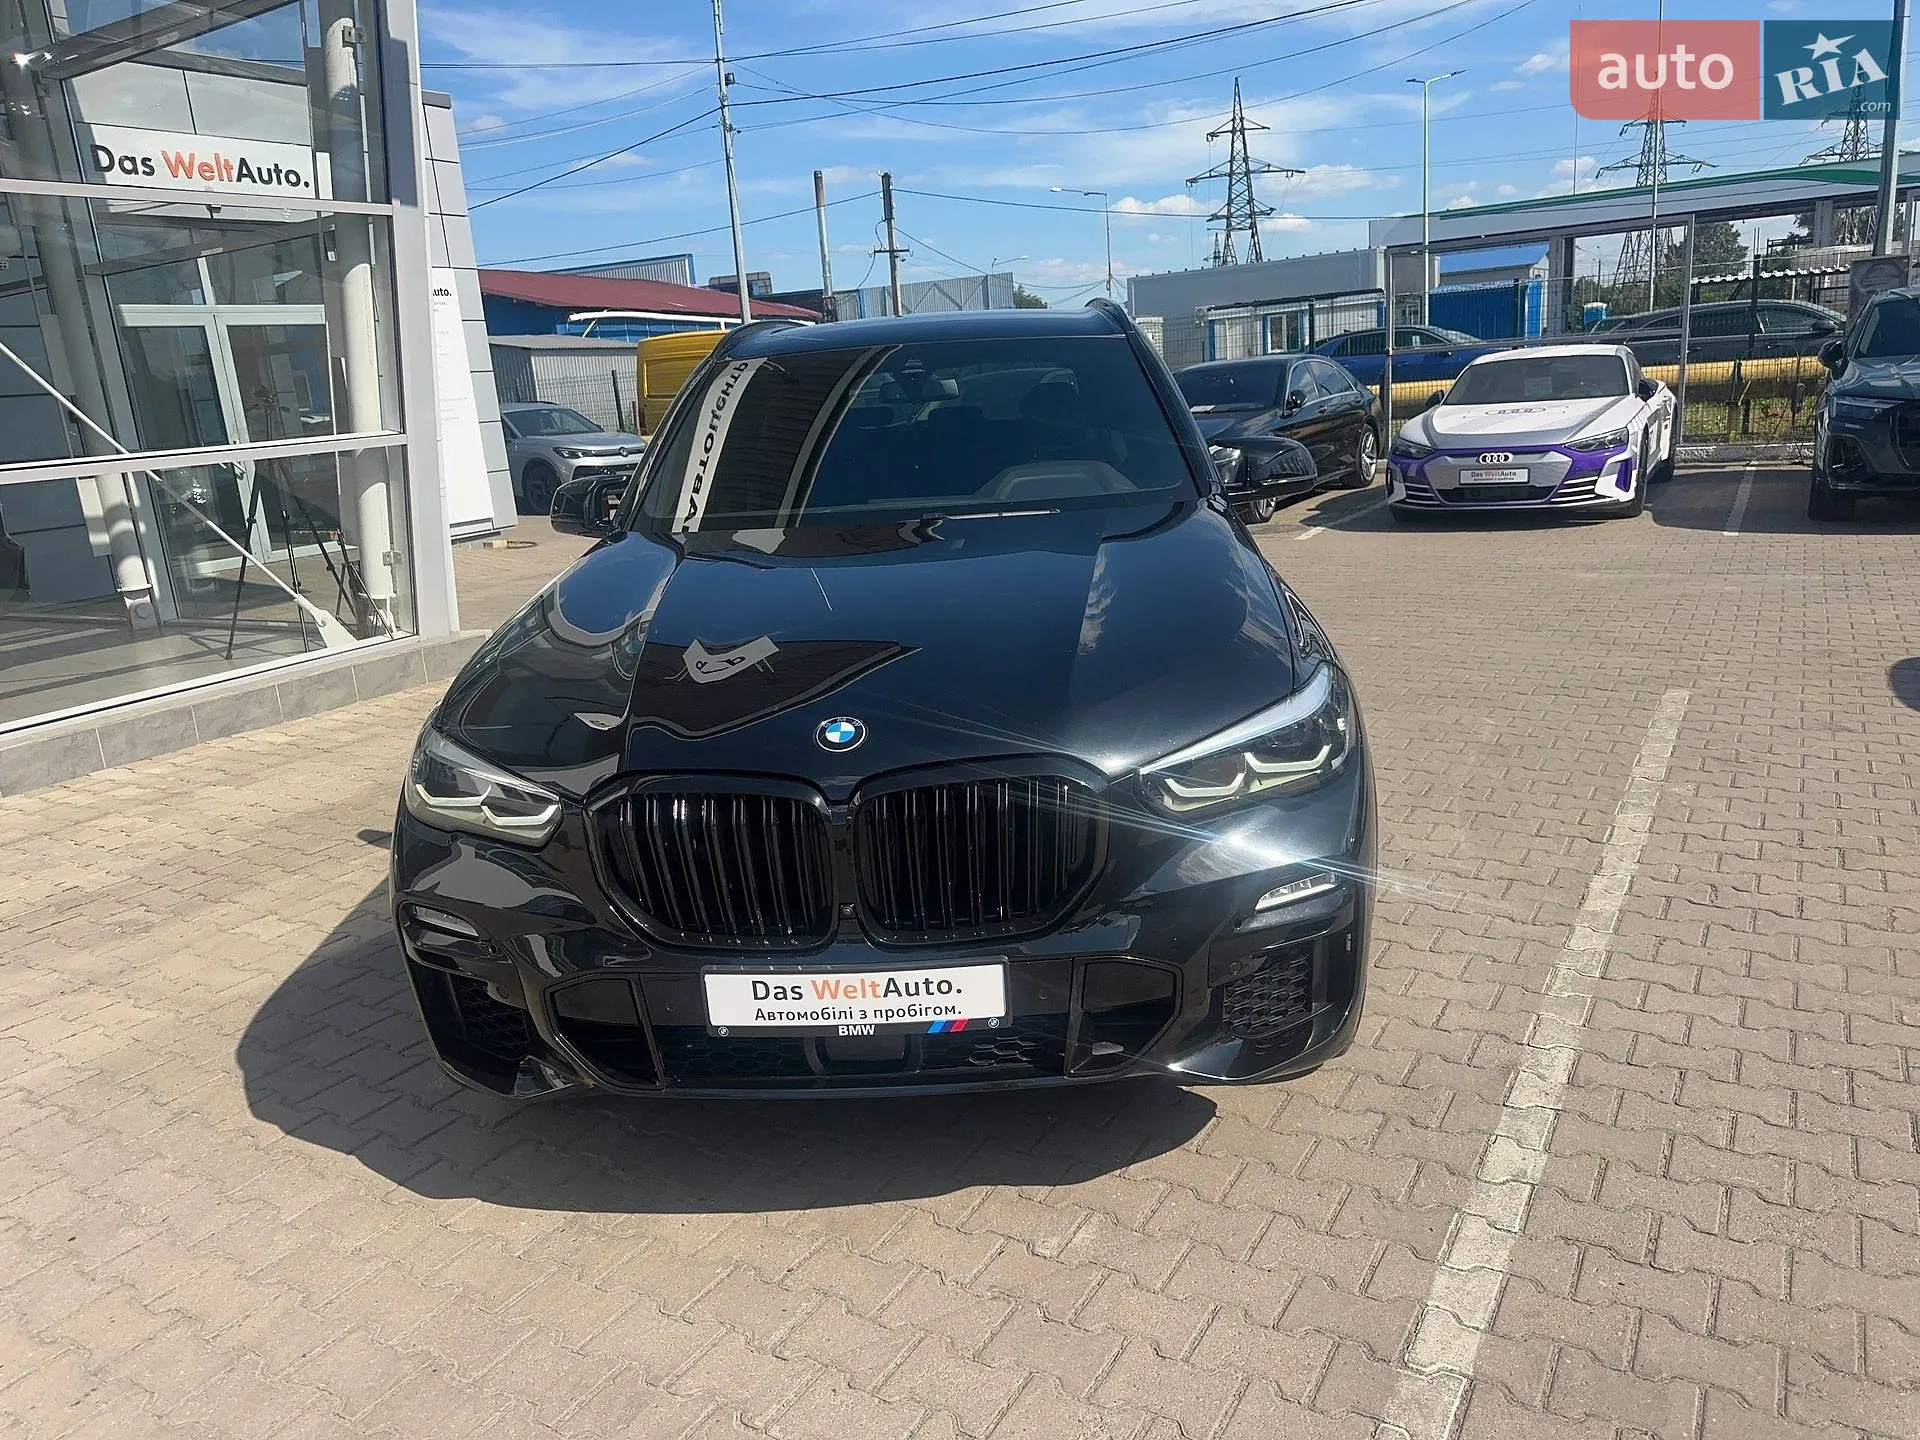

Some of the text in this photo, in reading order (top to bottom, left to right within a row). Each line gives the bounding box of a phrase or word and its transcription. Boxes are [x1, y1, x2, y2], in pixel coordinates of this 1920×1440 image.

[89, 144, 310, 188] Das WeltAuto.
[432, 287, 452, 297] uto.
[751, 976, 963, 1001] Das WeltAuto.
[754, 1003, 962, 1022] Автомобілі з пробігом.
[838, 1024, 875, 1036] BMW
